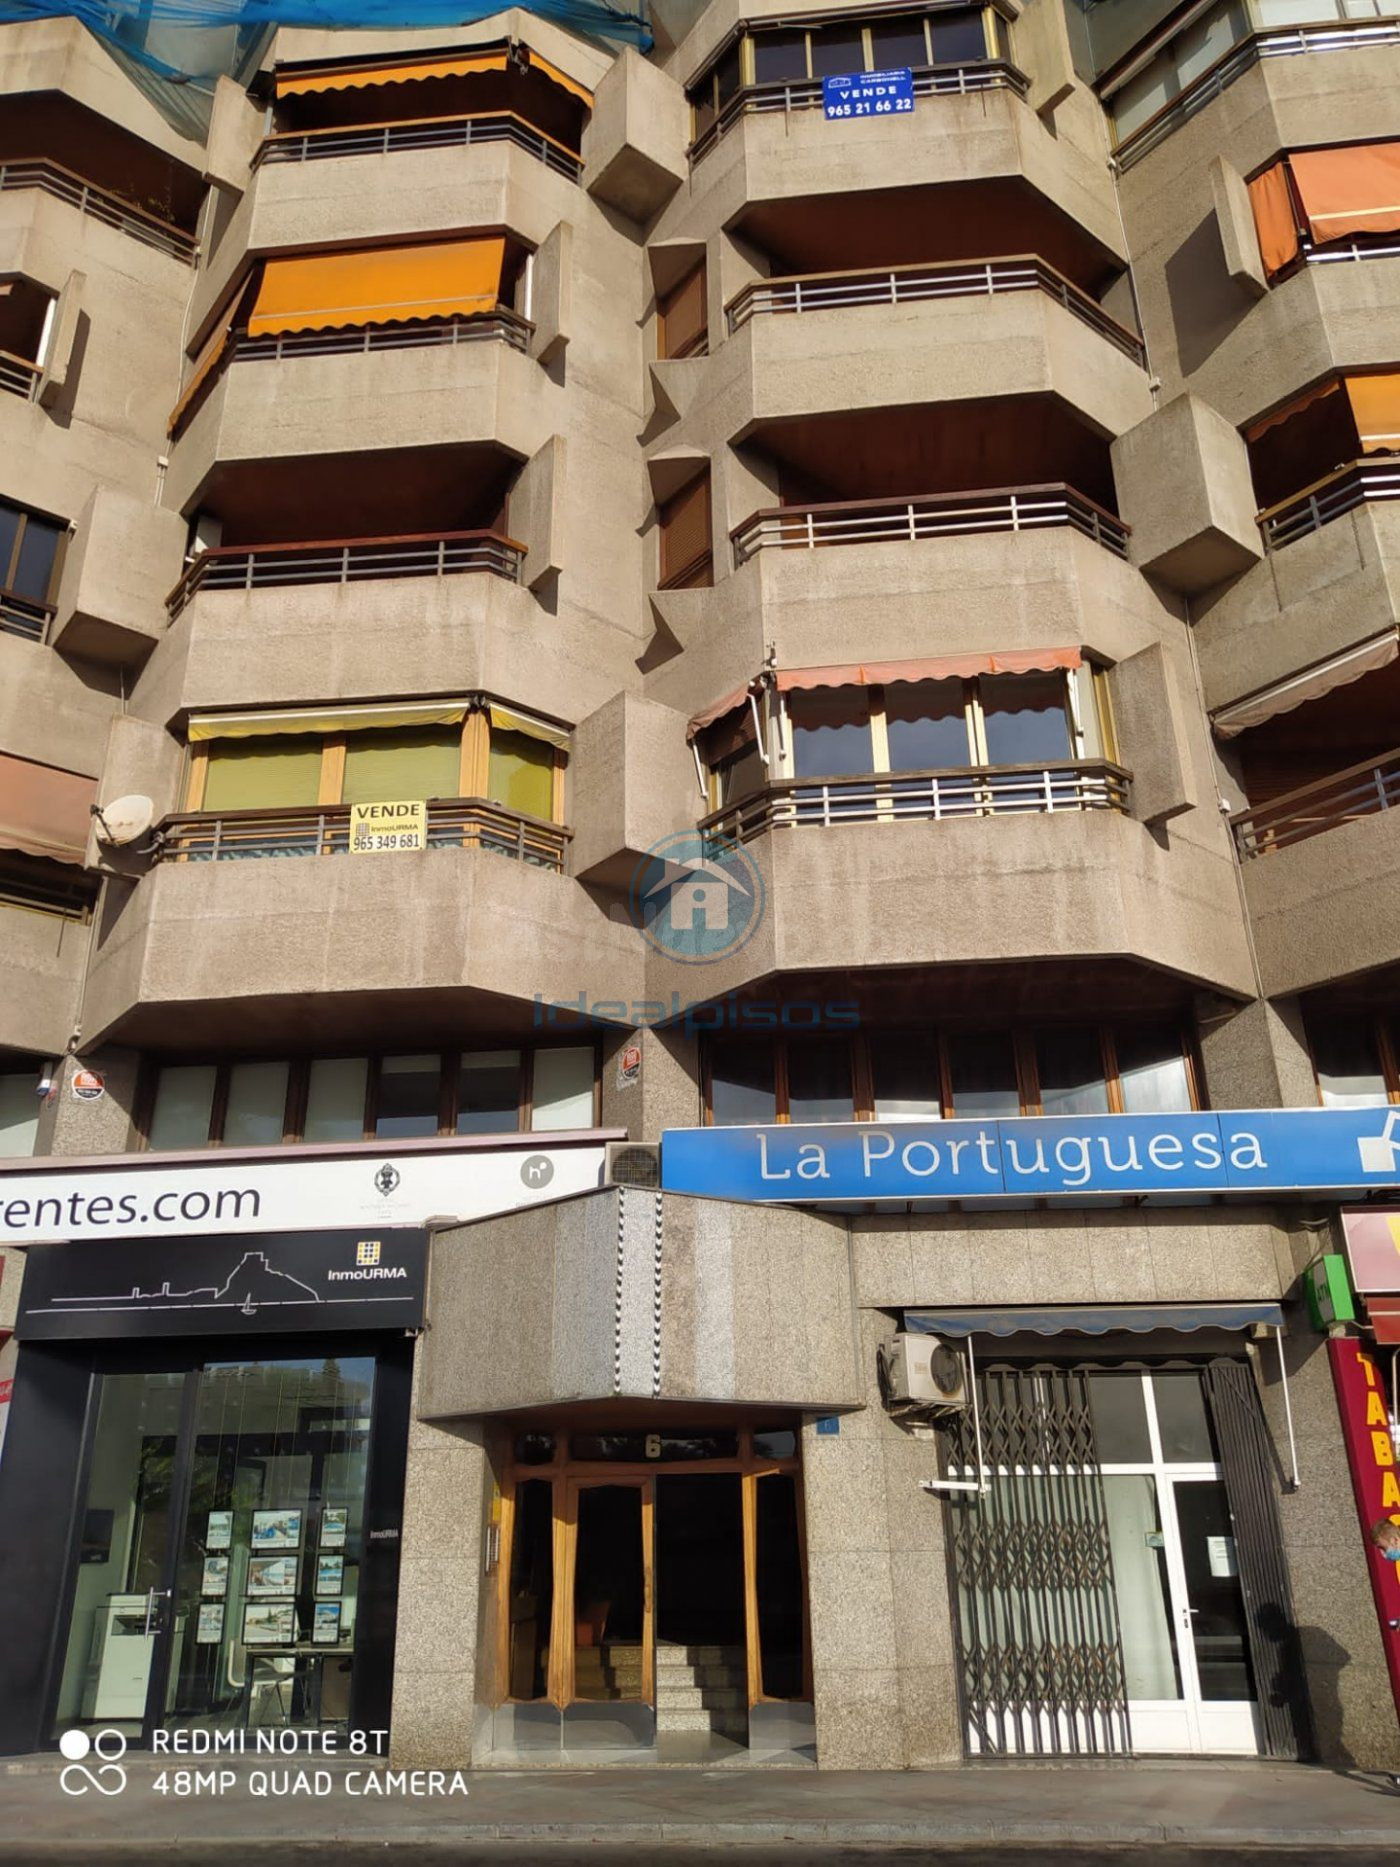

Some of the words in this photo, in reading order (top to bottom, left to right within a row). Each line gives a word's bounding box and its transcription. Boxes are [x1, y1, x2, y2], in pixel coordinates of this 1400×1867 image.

[840, 85, 897, 100] VENDE
[827, 104, 851, 117] 965
[855, 102, 870, 114] 21
[875, 100, 892, 112] 66
[895, 98, 912, 110] 22
[356, 804, 420, 819] VENDE
[353, 836, 373, 851] 965
[376, 835, 397, 849] 349
[399, 833, 420, 848] 681
[756, 1133, 831, 1181] La
[861, 1130, 1268, 1187] Portuguesa
[0, 1188, 262, 1228] entes.com
[327, 1267, 408, 1281] InmoURMA
[645, 1433, 661, 1458] 6
